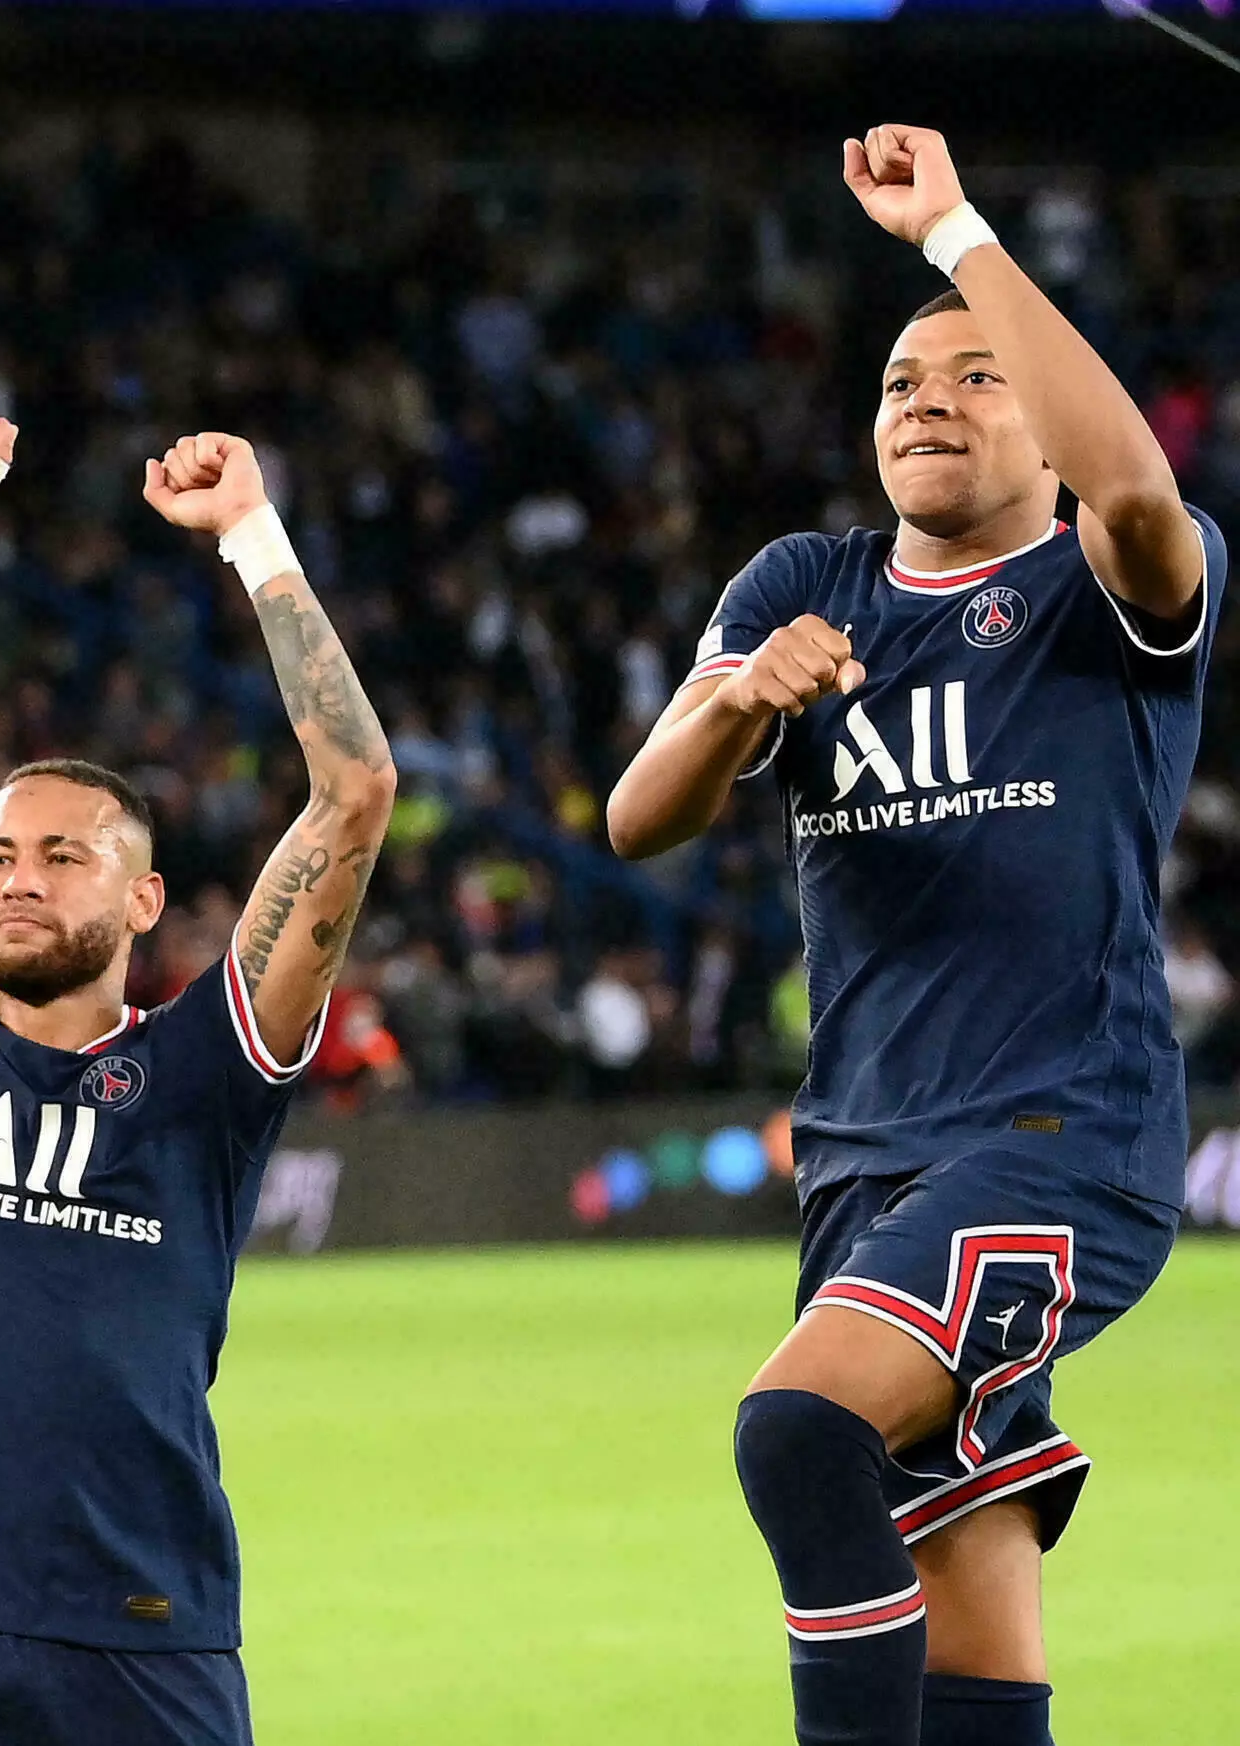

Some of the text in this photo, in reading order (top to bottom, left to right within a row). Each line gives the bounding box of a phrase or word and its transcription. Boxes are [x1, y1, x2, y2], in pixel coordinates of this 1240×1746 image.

[971, 590, 1014, 610] PARIS
[855, 800, 914, 832] LIVE
[919, 780, 1057, 823] LIMITLESS
[23, 1199, 162, 1245] LIMITLESS
